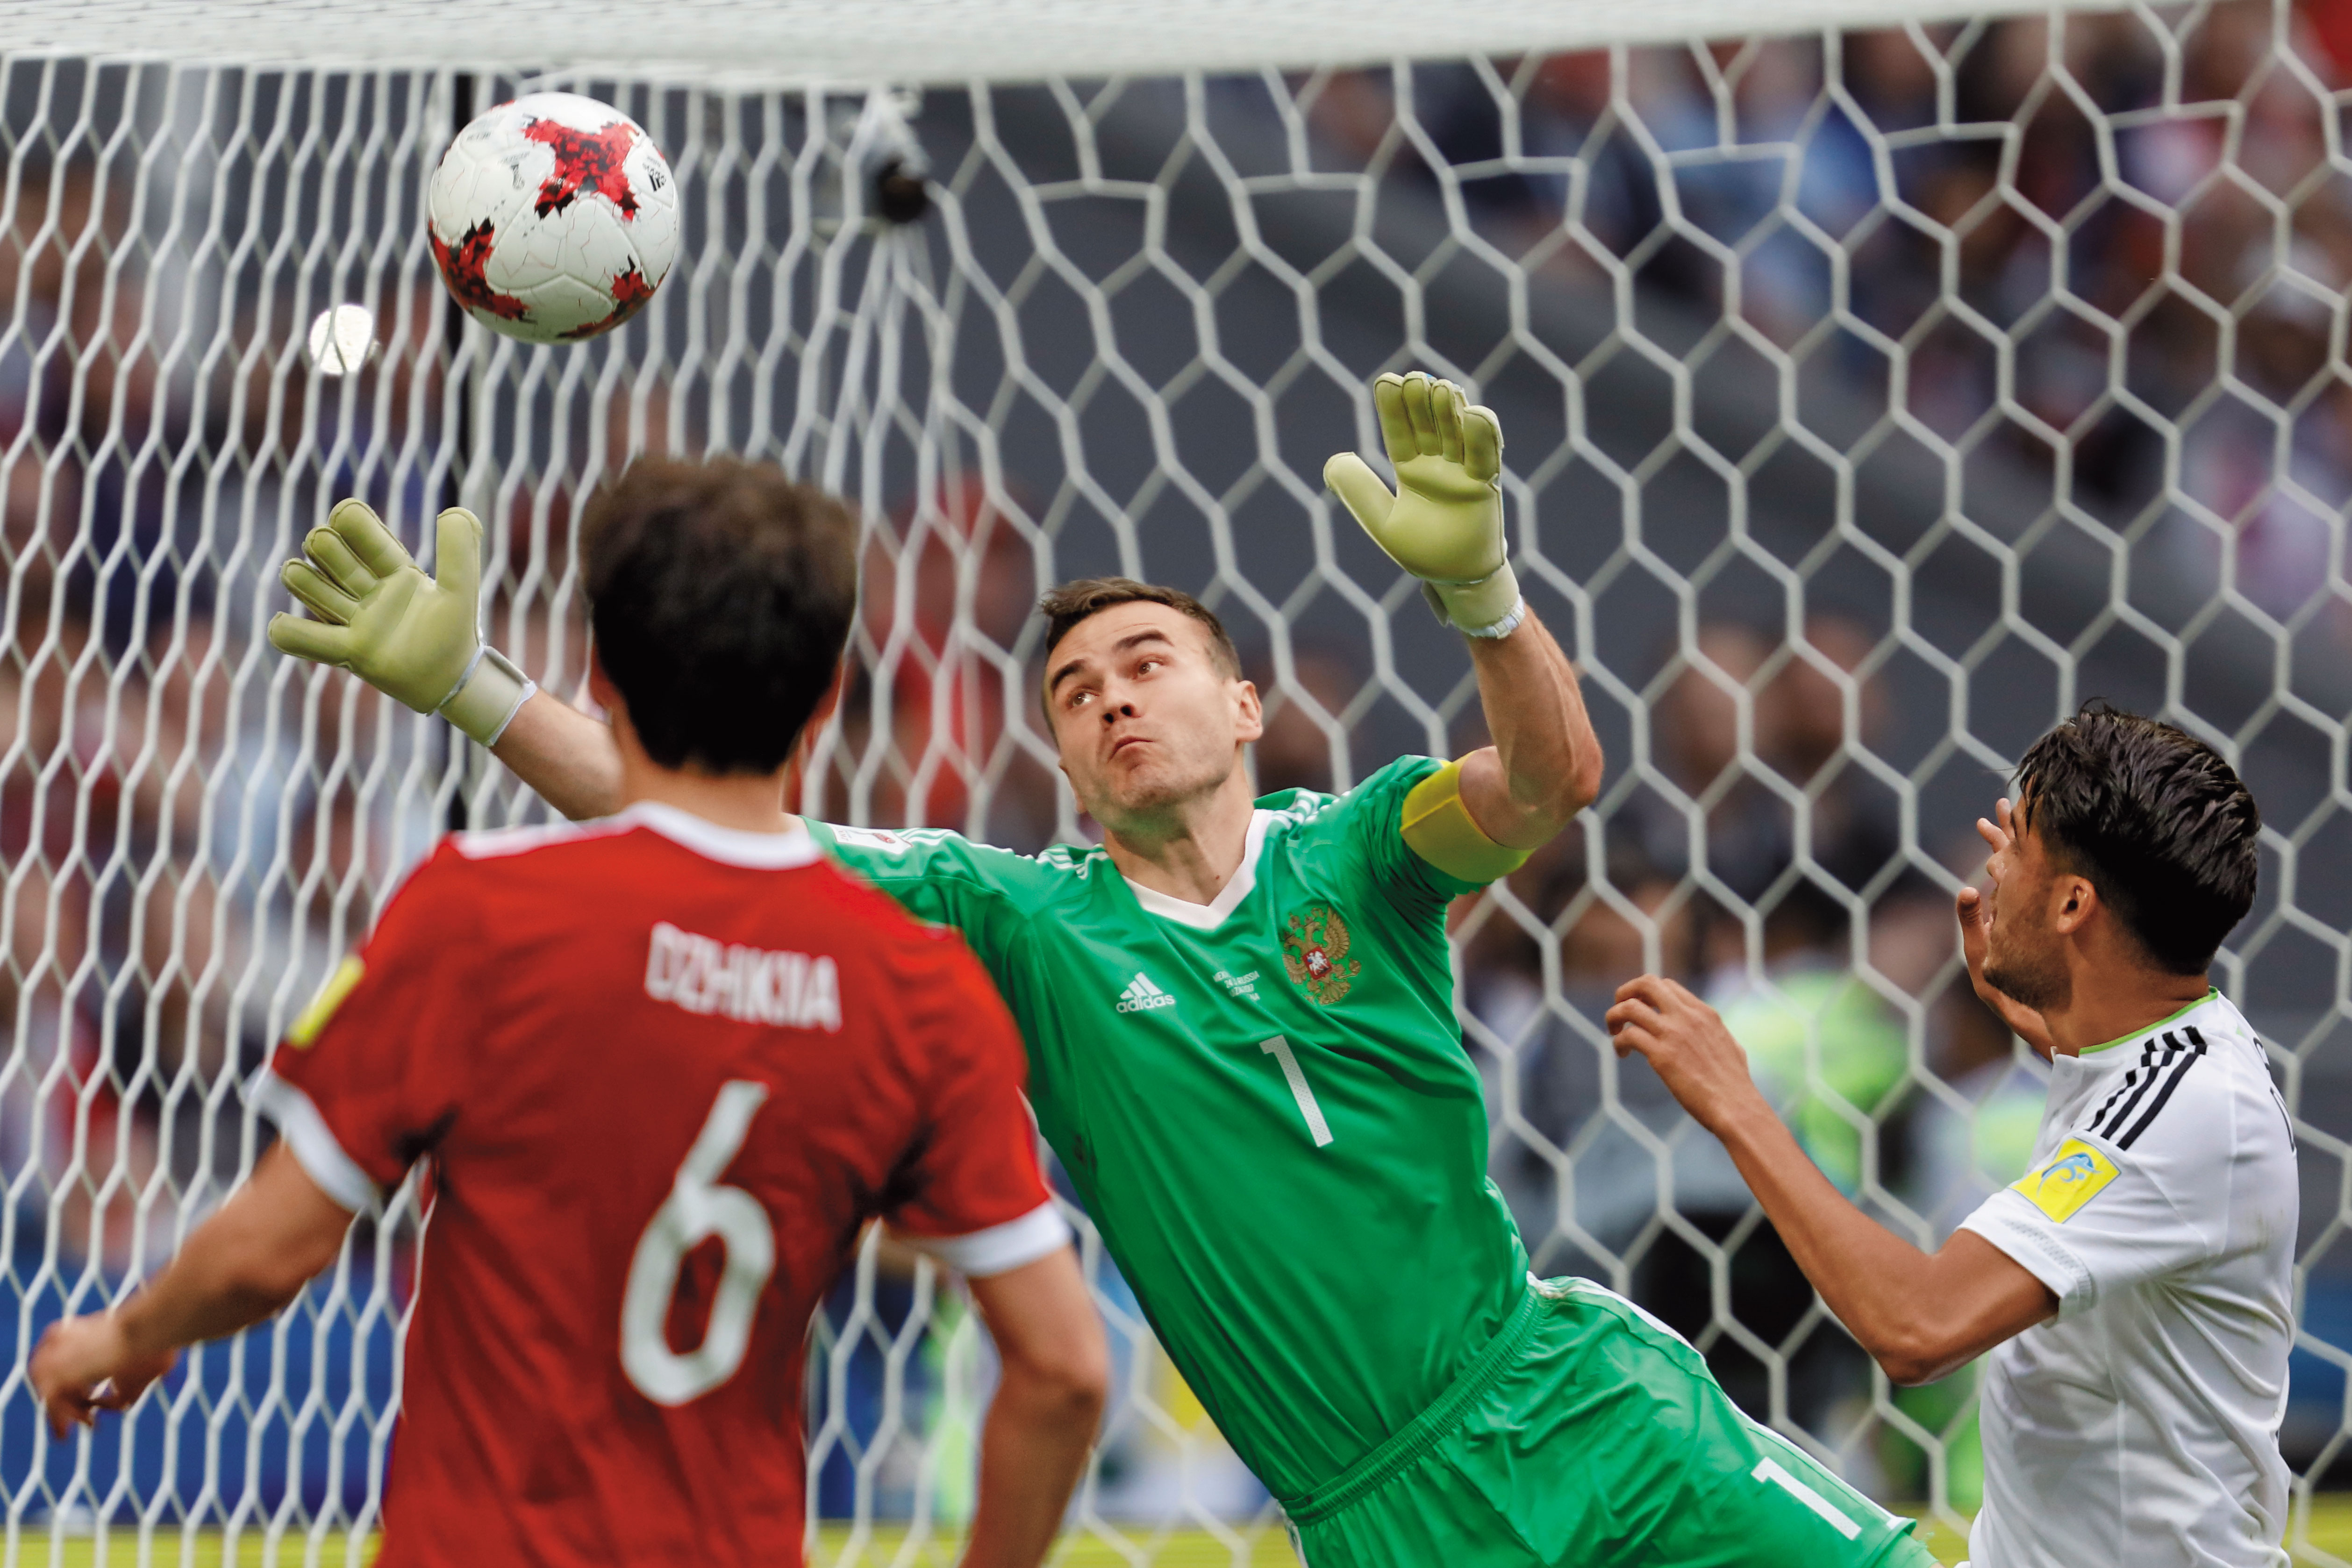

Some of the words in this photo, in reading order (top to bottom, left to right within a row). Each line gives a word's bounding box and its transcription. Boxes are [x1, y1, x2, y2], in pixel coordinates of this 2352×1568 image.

[1116, 994, 1175, 1013] adidas
[1259, 1034, 1334, 1147] 1
[619, 1080, 775, 1405] 6
[1751, 1456, 1862, 1541] 1
